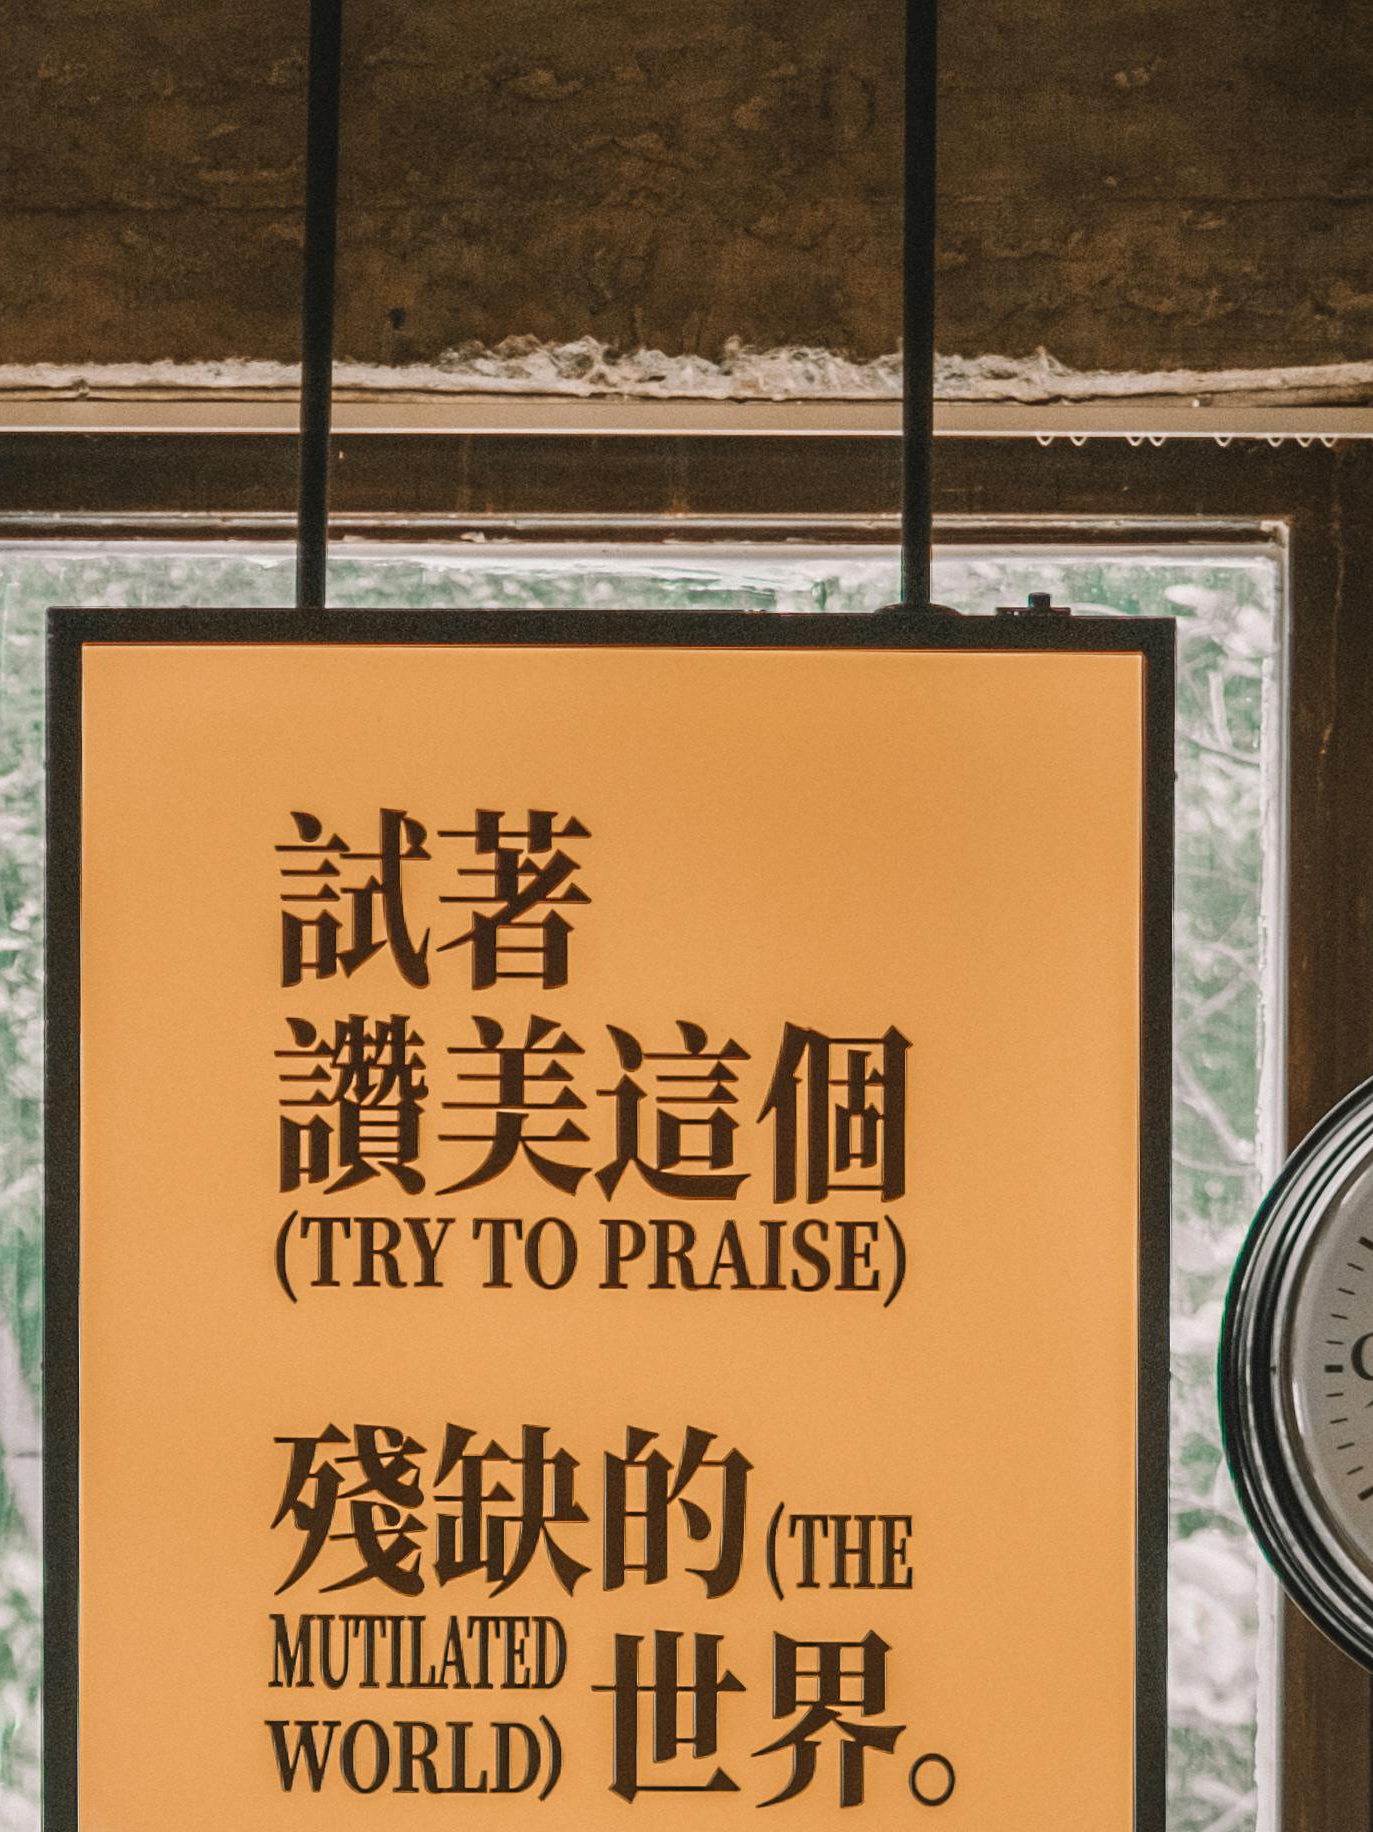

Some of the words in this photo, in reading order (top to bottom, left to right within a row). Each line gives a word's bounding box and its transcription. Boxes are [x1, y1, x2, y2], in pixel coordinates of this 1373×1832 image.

[272, 806, 594, 992] 試著
[273, 1013, 916, 1203] 讚美這個
[272, 1209, 459, 1306] (TRY
[473, 1218, 580, 1294] TO
[598, 1213, 909, 1308] PRAISE)
[271, 1422, 754, 1599] 殘缺的
[764, 1501, 915, 1602] (THE
[269, 1613, 568, 1692] MUTILATED
[591, 1628, 958, 1811] 世界。
[267, 1716, 563, 1802] WORLD)
